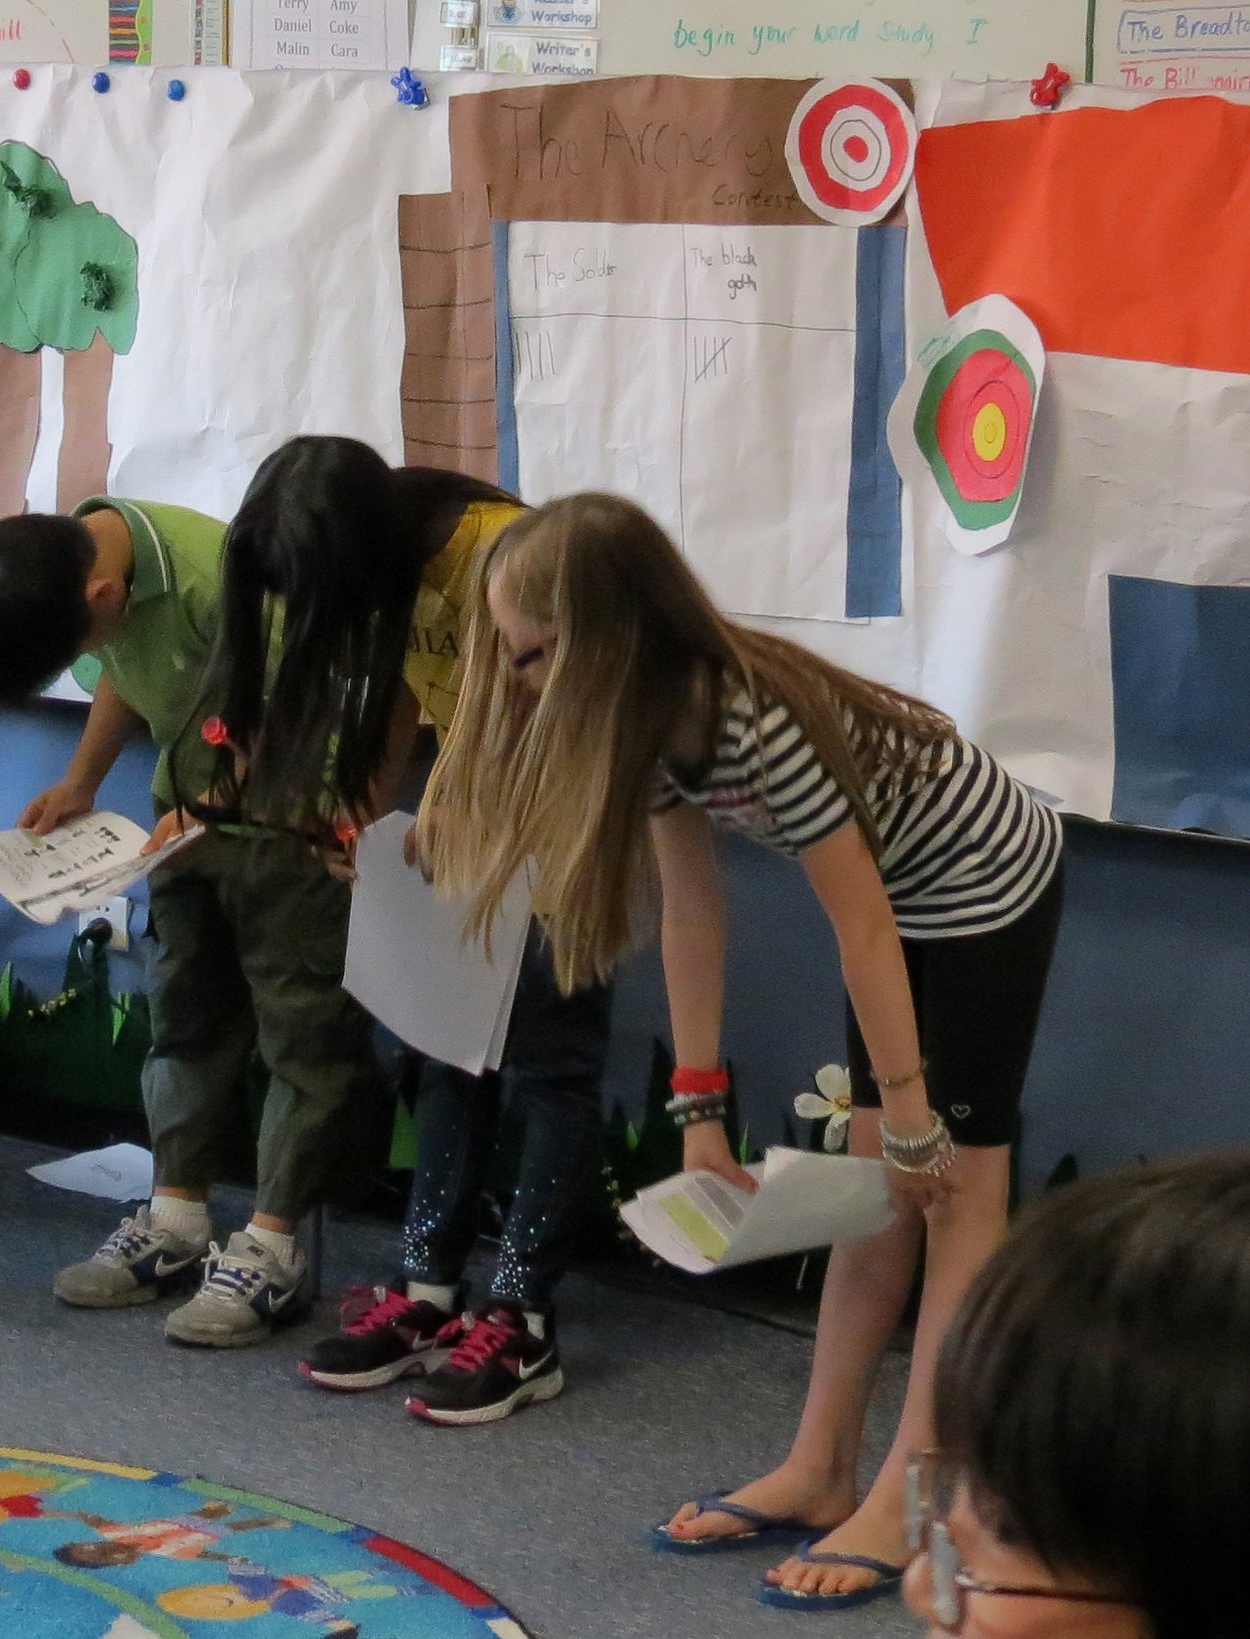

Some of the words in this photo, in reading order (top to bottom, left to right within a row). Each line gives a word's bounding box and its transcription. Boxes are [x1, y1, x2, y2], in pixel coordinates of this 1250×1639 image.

[330, 0, 357, 14] Amy
[274, 18, 313, 32] Daniel
[329, 20, 359, 34] Coke
[532, 10, 592, 25] Workshop
[673, 18, 735, 57] begin
[749, 23, 797, 55] your
[814, 19, 860, 43] word
[1127, 20, 1164, 43] The
[277, 41, 310, 56] Malin
[331, 43, 359, 58] Cara
[536, 41, 591, 57] Writer's
[1119, 67, 1154, 88] The
[500, 103, 583, 180] The
[689, 247, 713, 267] The
[524, 253, 566, 290] The
